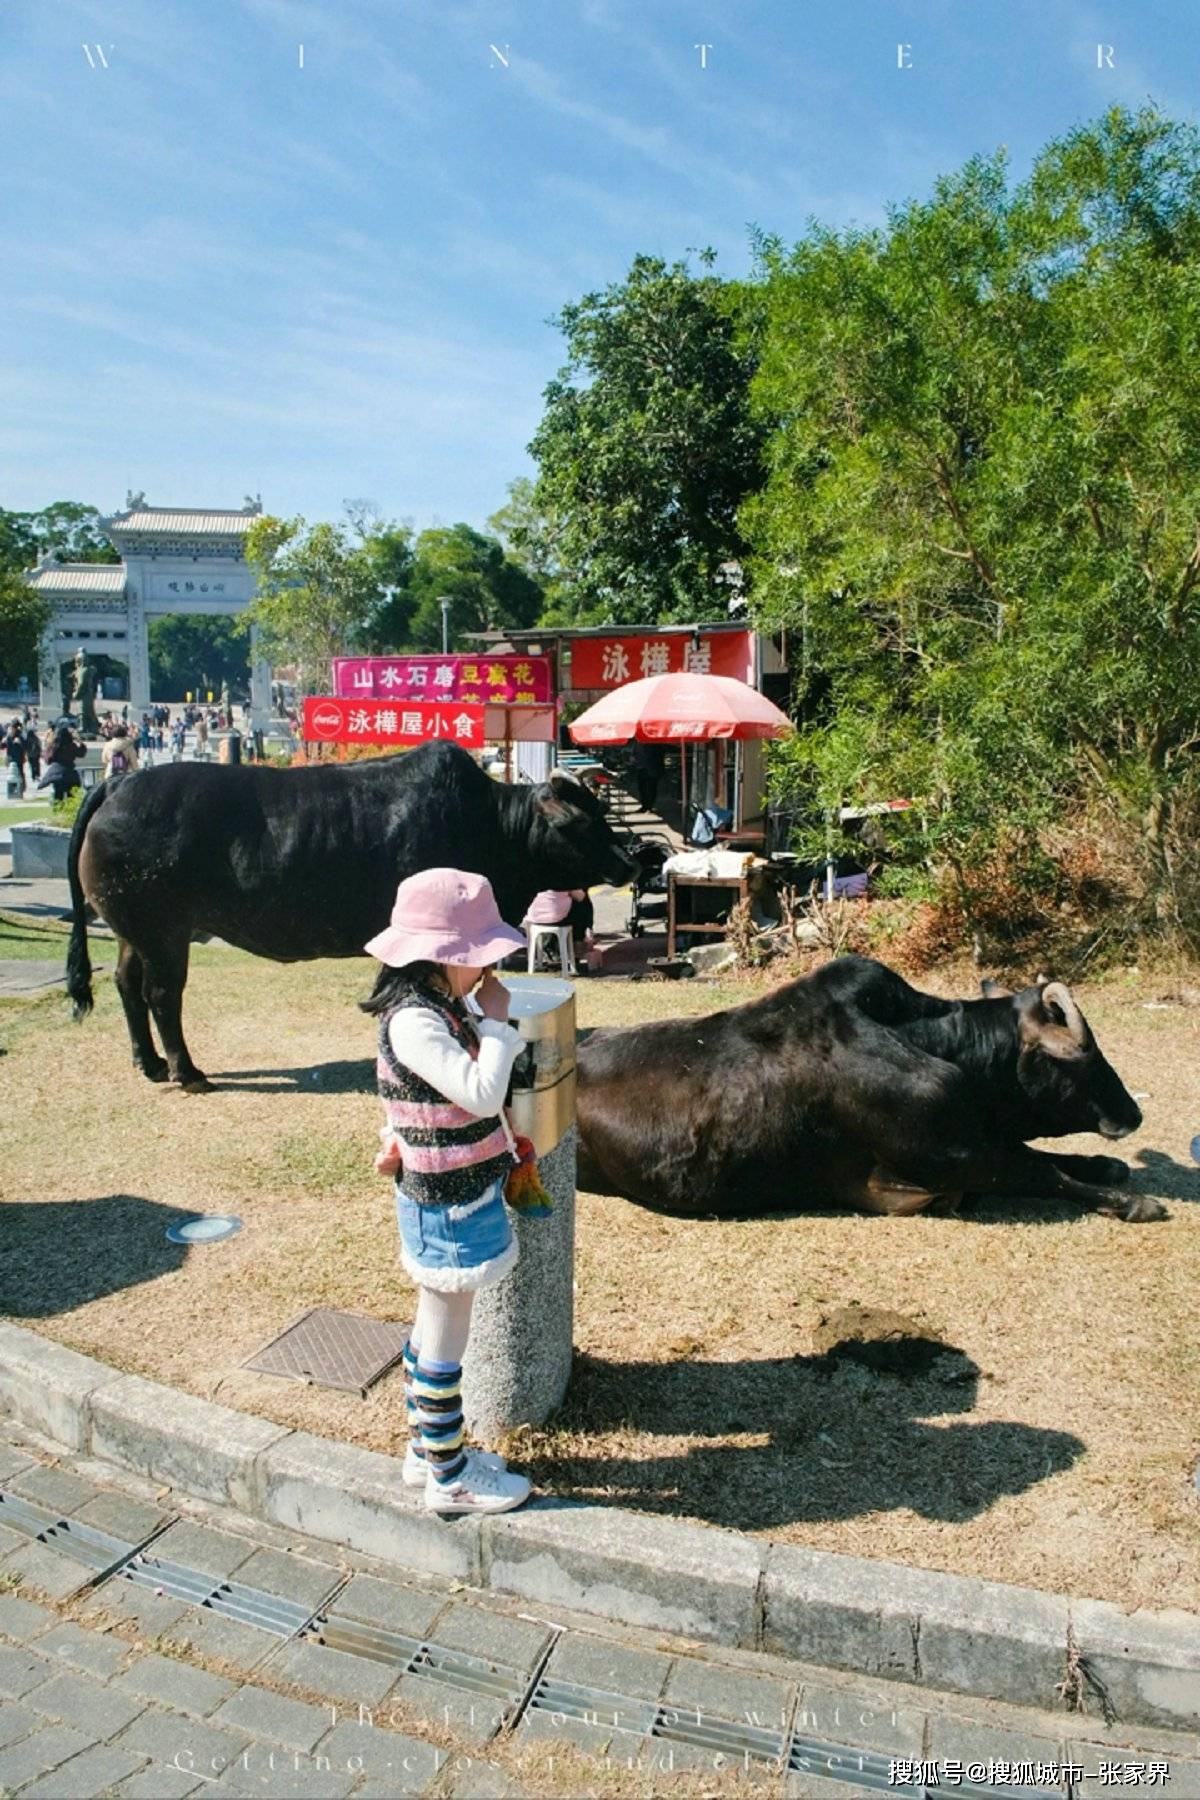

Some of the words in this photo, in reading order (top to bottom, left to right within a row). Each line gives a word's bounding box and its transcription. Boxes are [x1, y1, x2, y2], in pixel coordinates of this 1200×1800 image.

[347, 709, 477, 739] 泳樺屋小食
